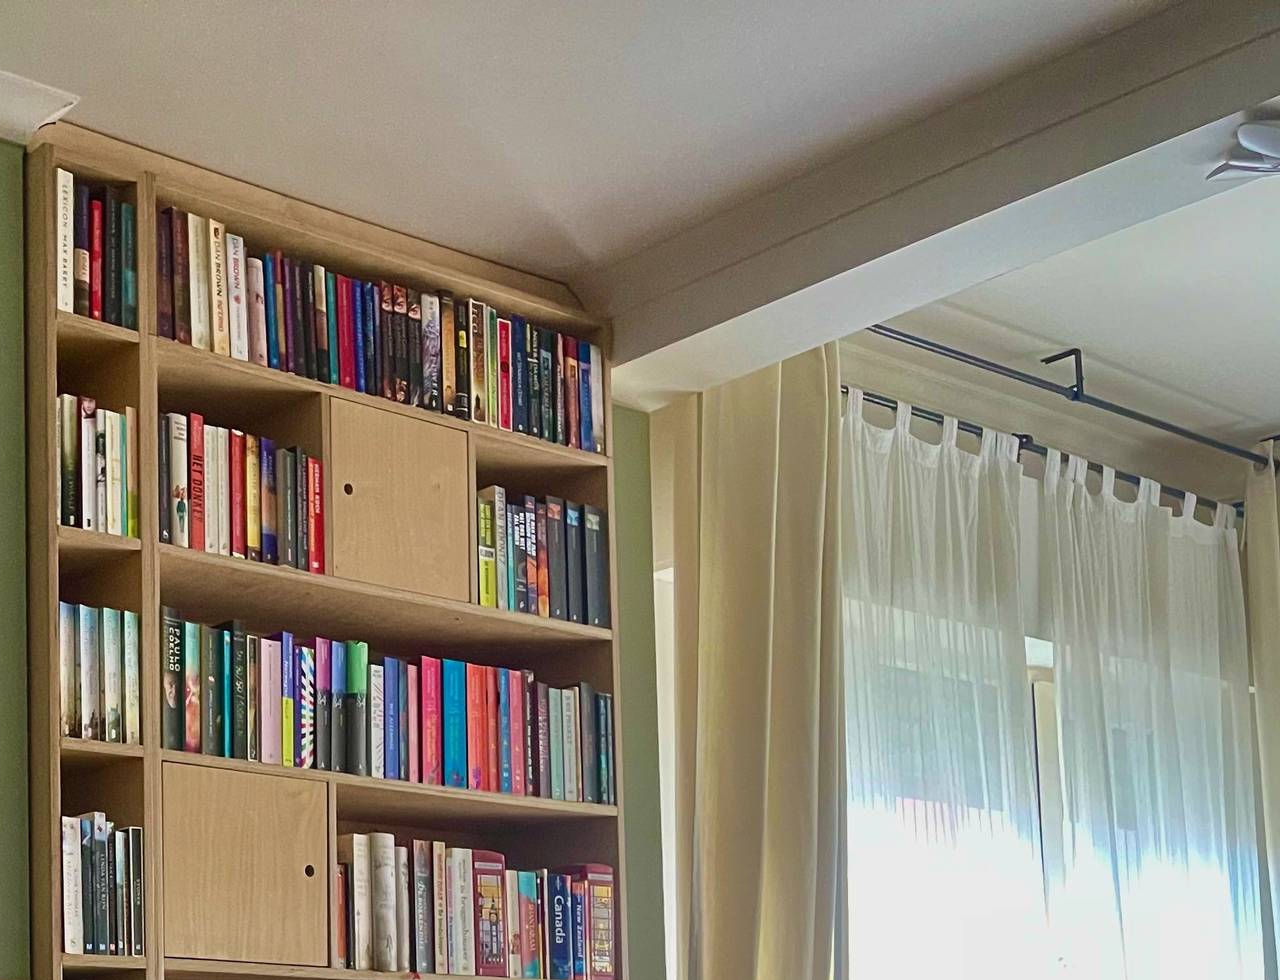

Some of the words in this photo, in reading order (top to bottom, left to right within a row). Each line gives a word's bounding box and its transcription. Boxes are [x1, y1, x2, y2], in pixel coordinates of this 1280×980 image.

[231, 237, 239, 256] DAN
[215, 262, 223, 297] BROWN
[232, 257, 241, 290] BROWN
[193, 454, 203, 473] HET
[554, 895, 566, 944] Canada
